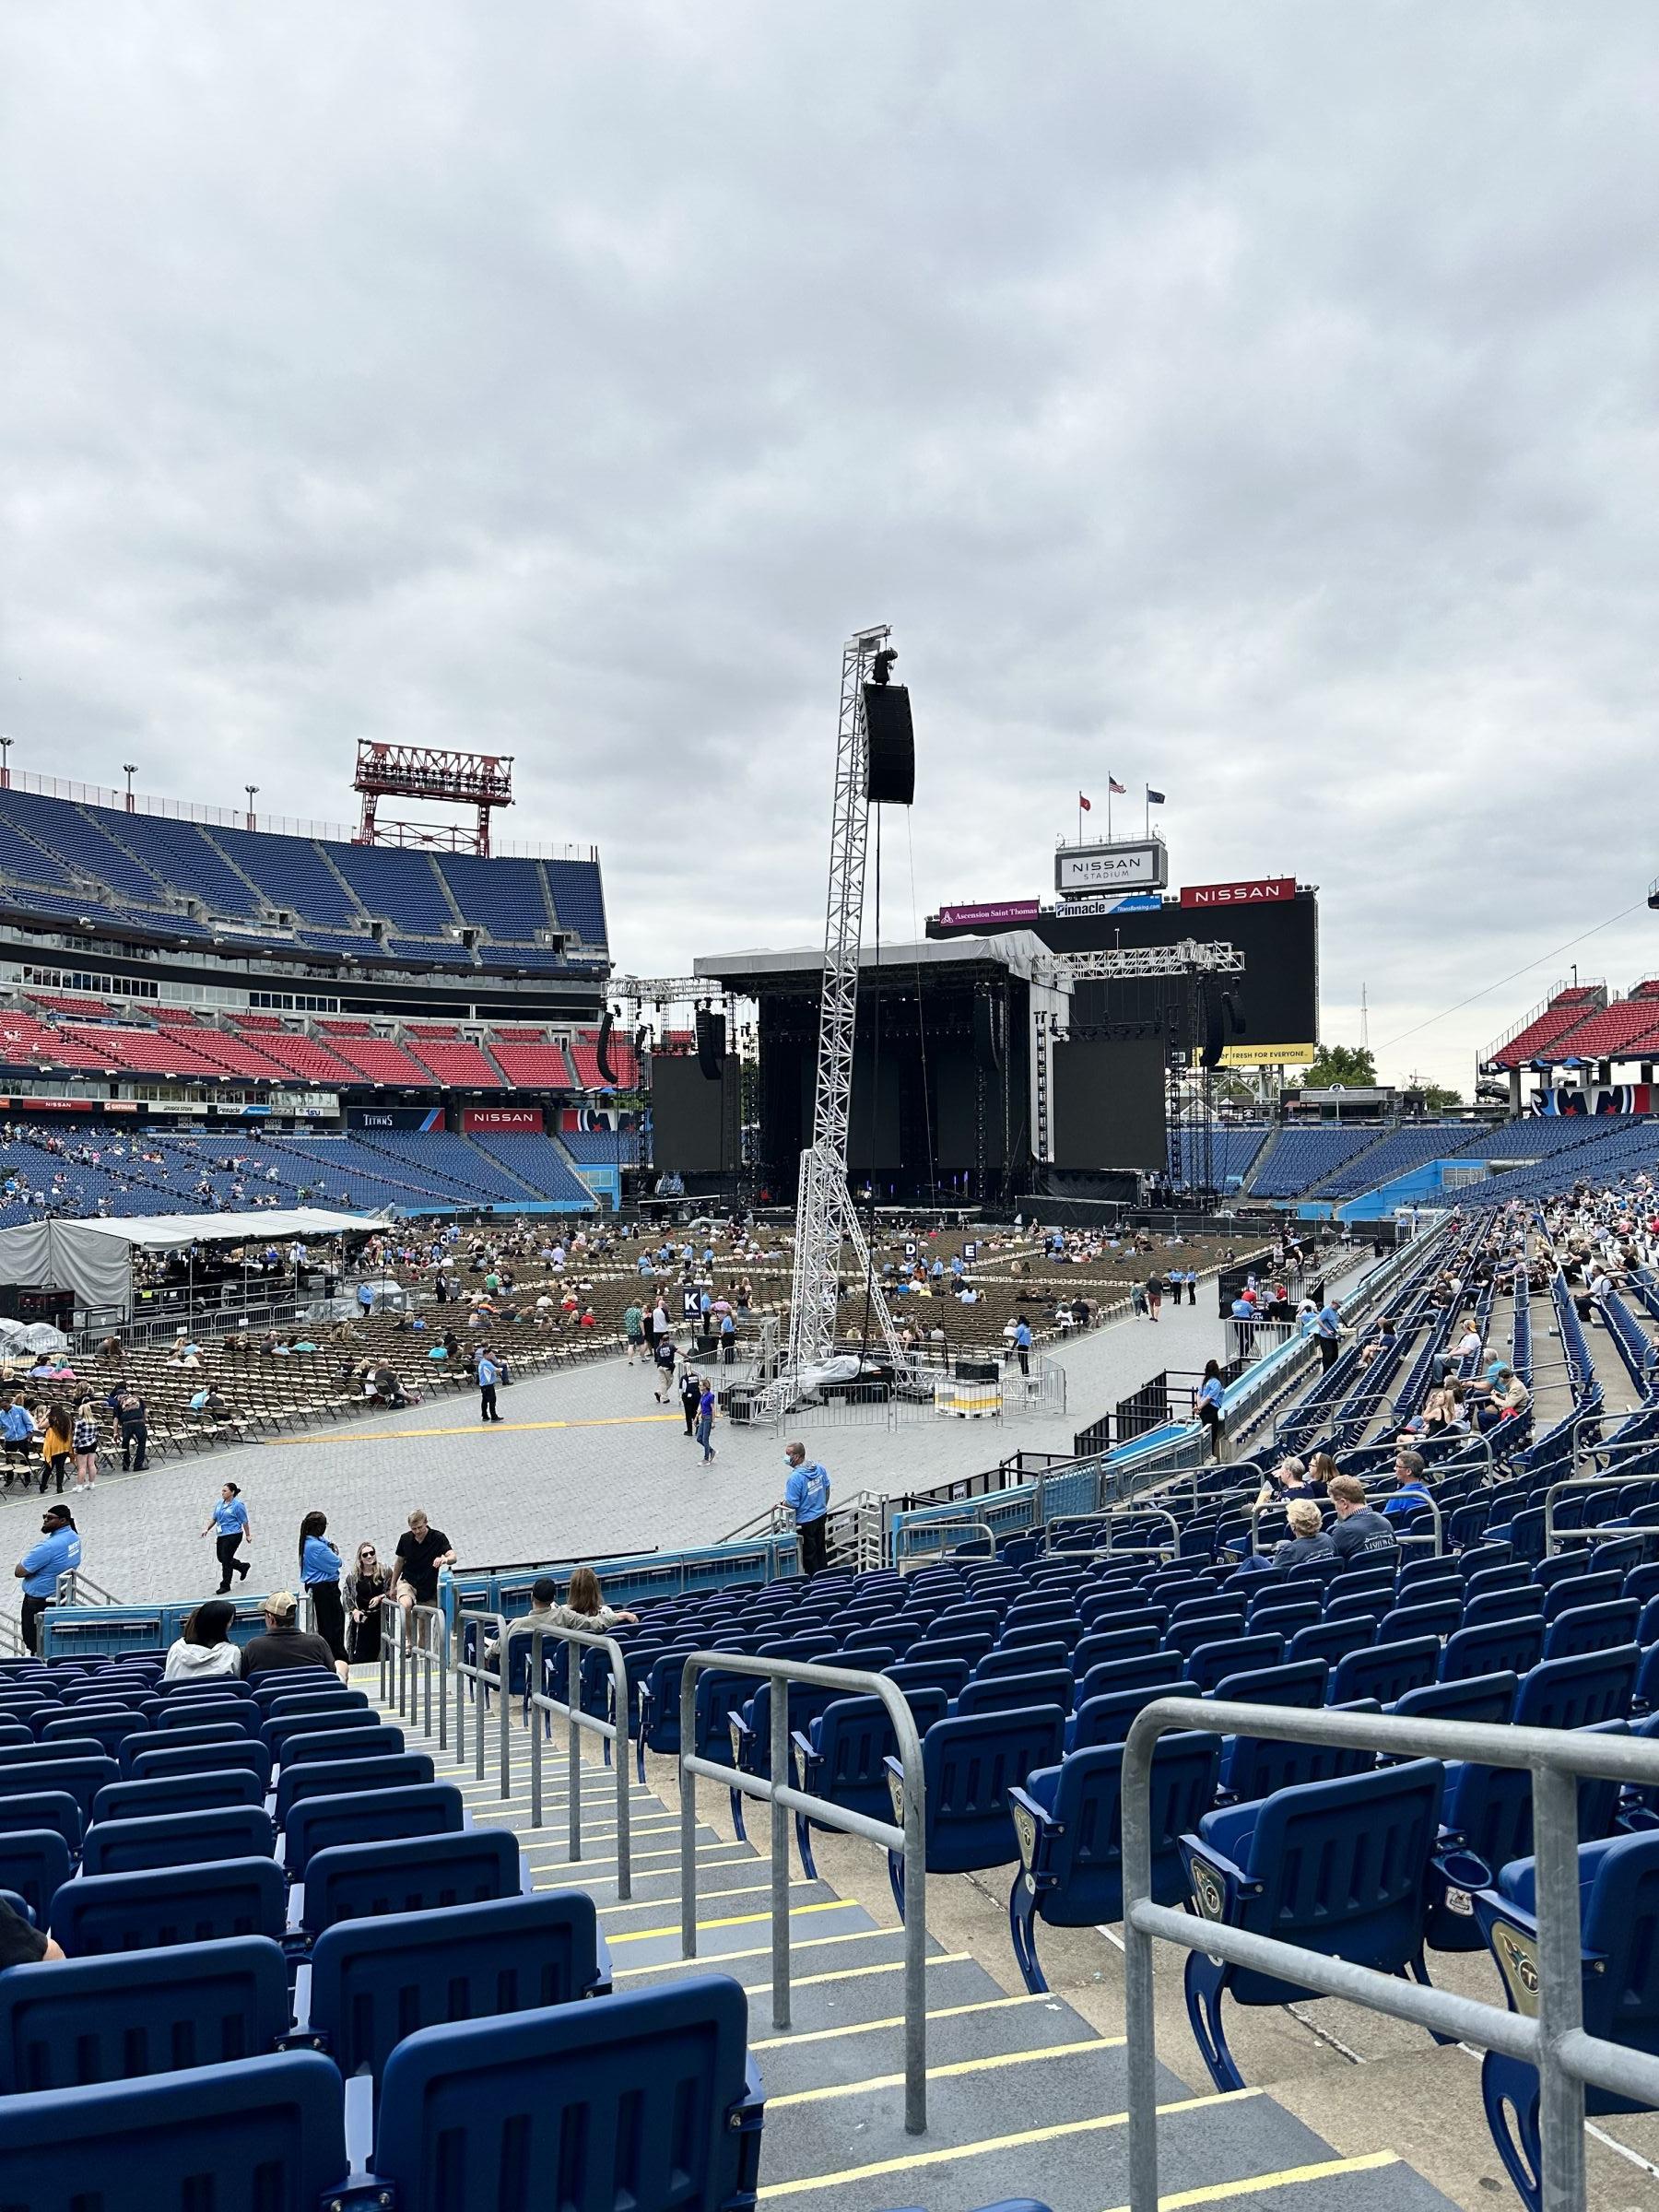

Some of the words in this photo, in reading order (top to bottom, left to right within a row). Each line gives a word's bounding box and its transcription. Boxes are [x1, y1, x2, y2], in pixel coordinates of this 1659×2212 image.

[1073, 858, 1140, 873] NISSAN
[1084, 870, 1129, 880] STADIUM
[1195, 885, 1279, 902] NISSAN
[955, 911, 990, 920] Ascension
[990, 909, 1009, 917] Saint
[1009, 907, 1038, 915] Thomas
[1057, 901, 1106, 916] Pinnacle
[474, 1113, 534, 1122] NISSAN
[905, 1242, 916, 1254] D
[965, 1244, 975, 1256] E
[685, 1292, 699, 1310] K
